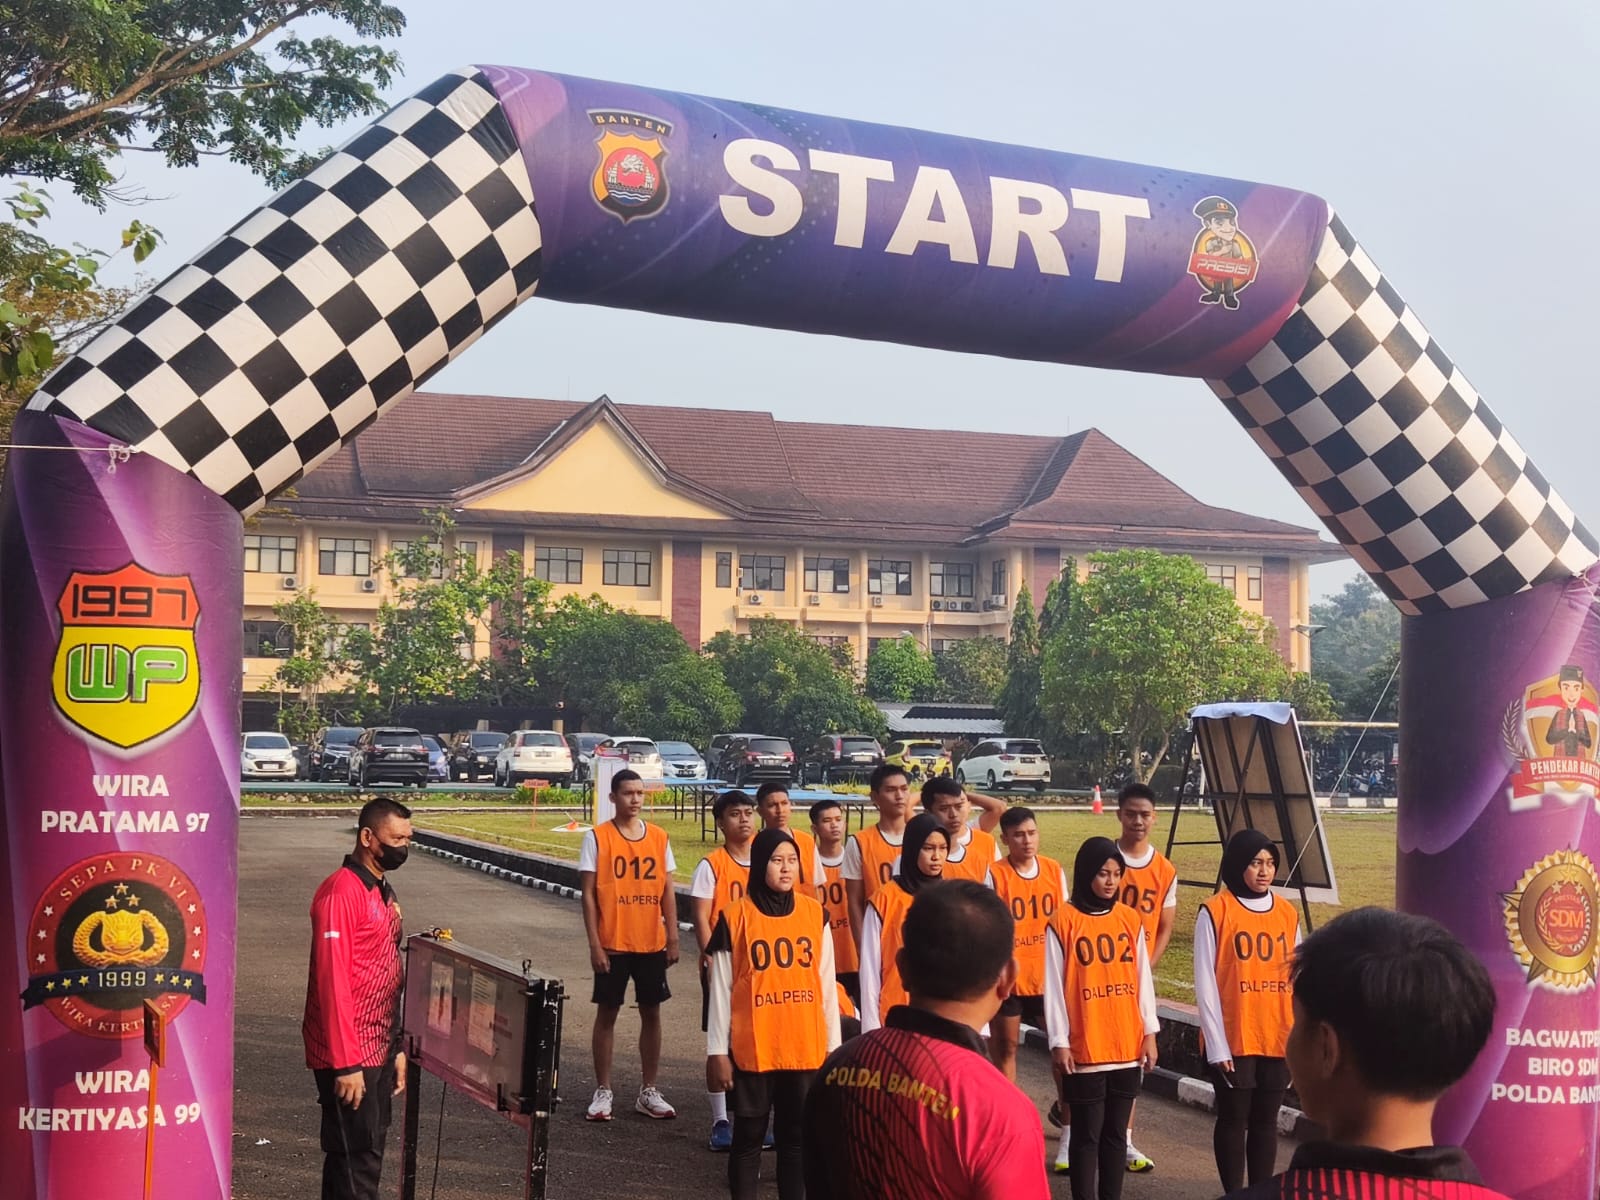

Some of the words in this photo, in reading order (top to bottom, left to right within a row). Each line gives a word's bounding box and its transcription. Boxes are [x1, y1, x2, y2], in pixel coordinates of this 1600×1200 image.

[595, 115, 666, 134] BANTEN
[719, 138, 1151, 283] START
[1197, 258, 1251, 275] PRESISI
[73, 583, 187, 621] 1997
[66, 644, 188, 702] WP
[1530, 760, 1578, 775] PENDEKAR
[93, 775, 169, 797] WIRA
[41, 811, 179, 833] PRATAMA
[186, 813, 209, 833] 97
[60, 860, 116, 900] SEPA
[131, 858, 160, 876] PK
[168, 876, 187, 899] VI
[614, 855, 657, 880] 012
[618, 895, 659, 905] ALPERS
[1012, 893, 1054, 920] 010
[1549, 909, 1584, 928] SDM
[1015, 934, 1045, 948] DALPE
[1075, 933, 1134, 967] 002
[1234, 931, 1287, 961] 001
[751, 936, 813, 971] 003
[99, 971, 147, 987] 1999
[755, 990, 814, 1007] DALPERS
[1082, 983, 1135, 1001] DALPERS
[61, 996, 92, 1028] WIRA
[1528, 1057, 1574, 1076] BIRO
[75, 1069, 150, 1094] WIRA
[825, 1067, 881, 1090] POLDA
[887, 1073, 960, 1120] BANTEN
[1492, 1083, 1566, 1104] POLDA
[18, 1104, 166, 1131] KERTIYASA
[174, 1102, 200, 1125] 99
